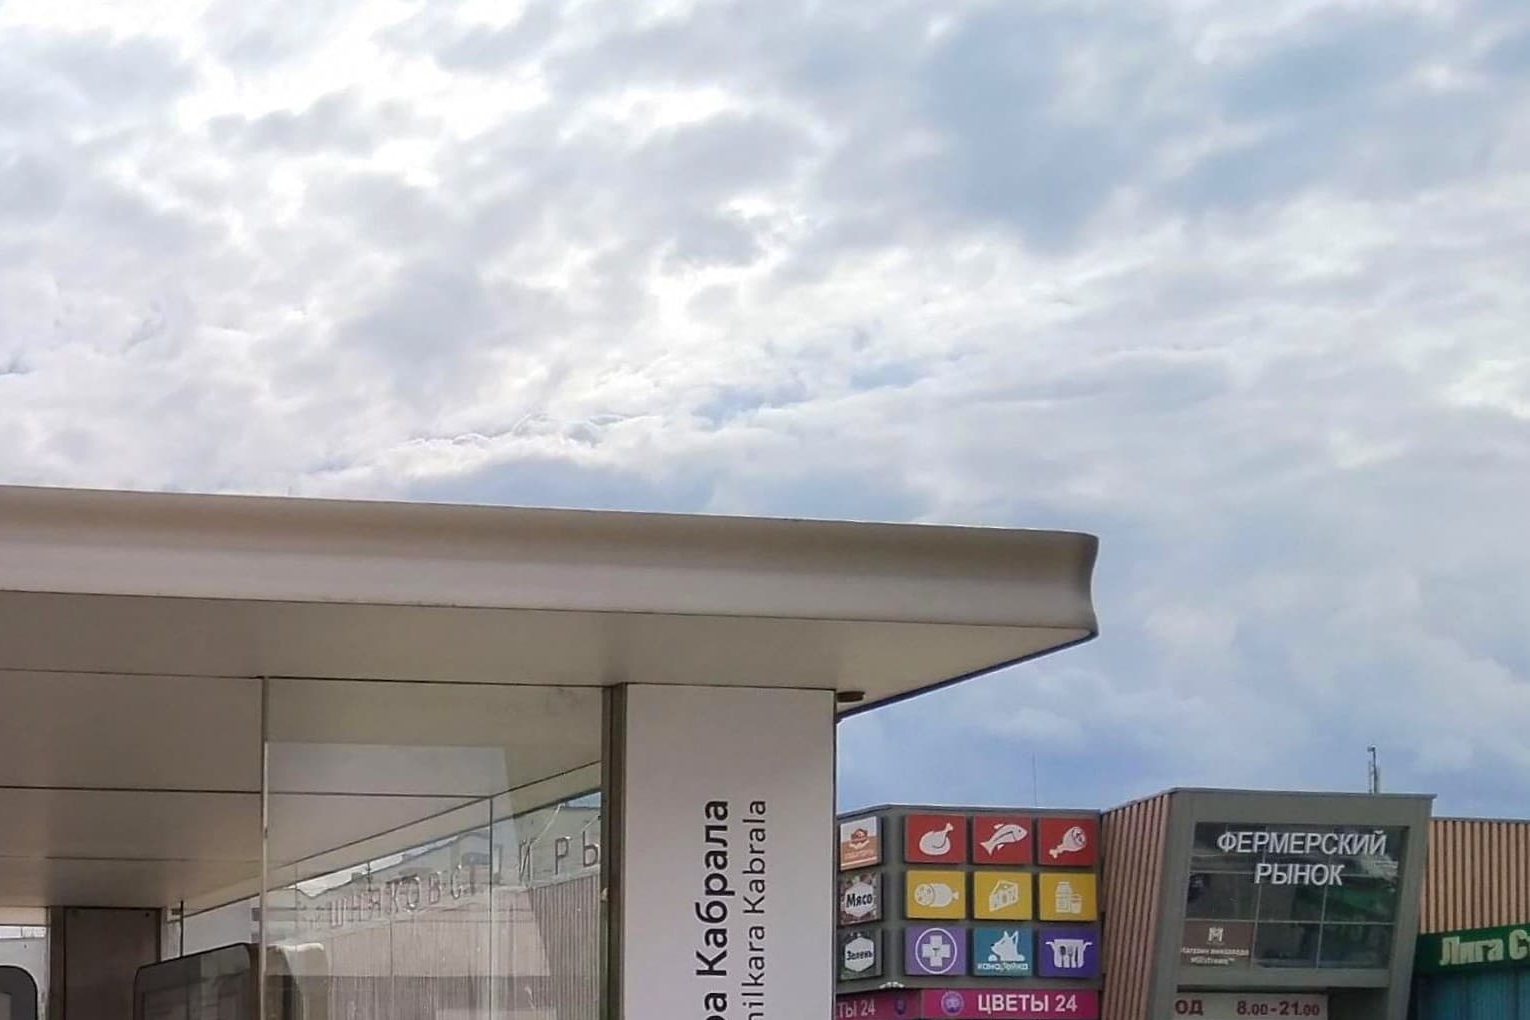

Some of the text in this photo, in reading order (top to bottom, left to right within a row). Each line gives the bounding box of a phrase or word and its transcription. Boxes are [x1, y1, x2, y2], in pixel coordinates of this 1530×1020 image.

[1217, 830, 1387, 855] ФЕРМЕРСКИЙ
[741, 799, 766, 915] Kabrala
[1254, 863, 1345, 886] РЫНОК
[695, 799, 735, 977] Кабрала
[846, 893, 873, 907] Мясо
[846, 950, 873, 961] Зелень
[1439, 936, 1504, 966] Лига
[860, 1000, 875, 1017] 24
[978, 995, 1078, 1015] ЦВЕТЫ 24
